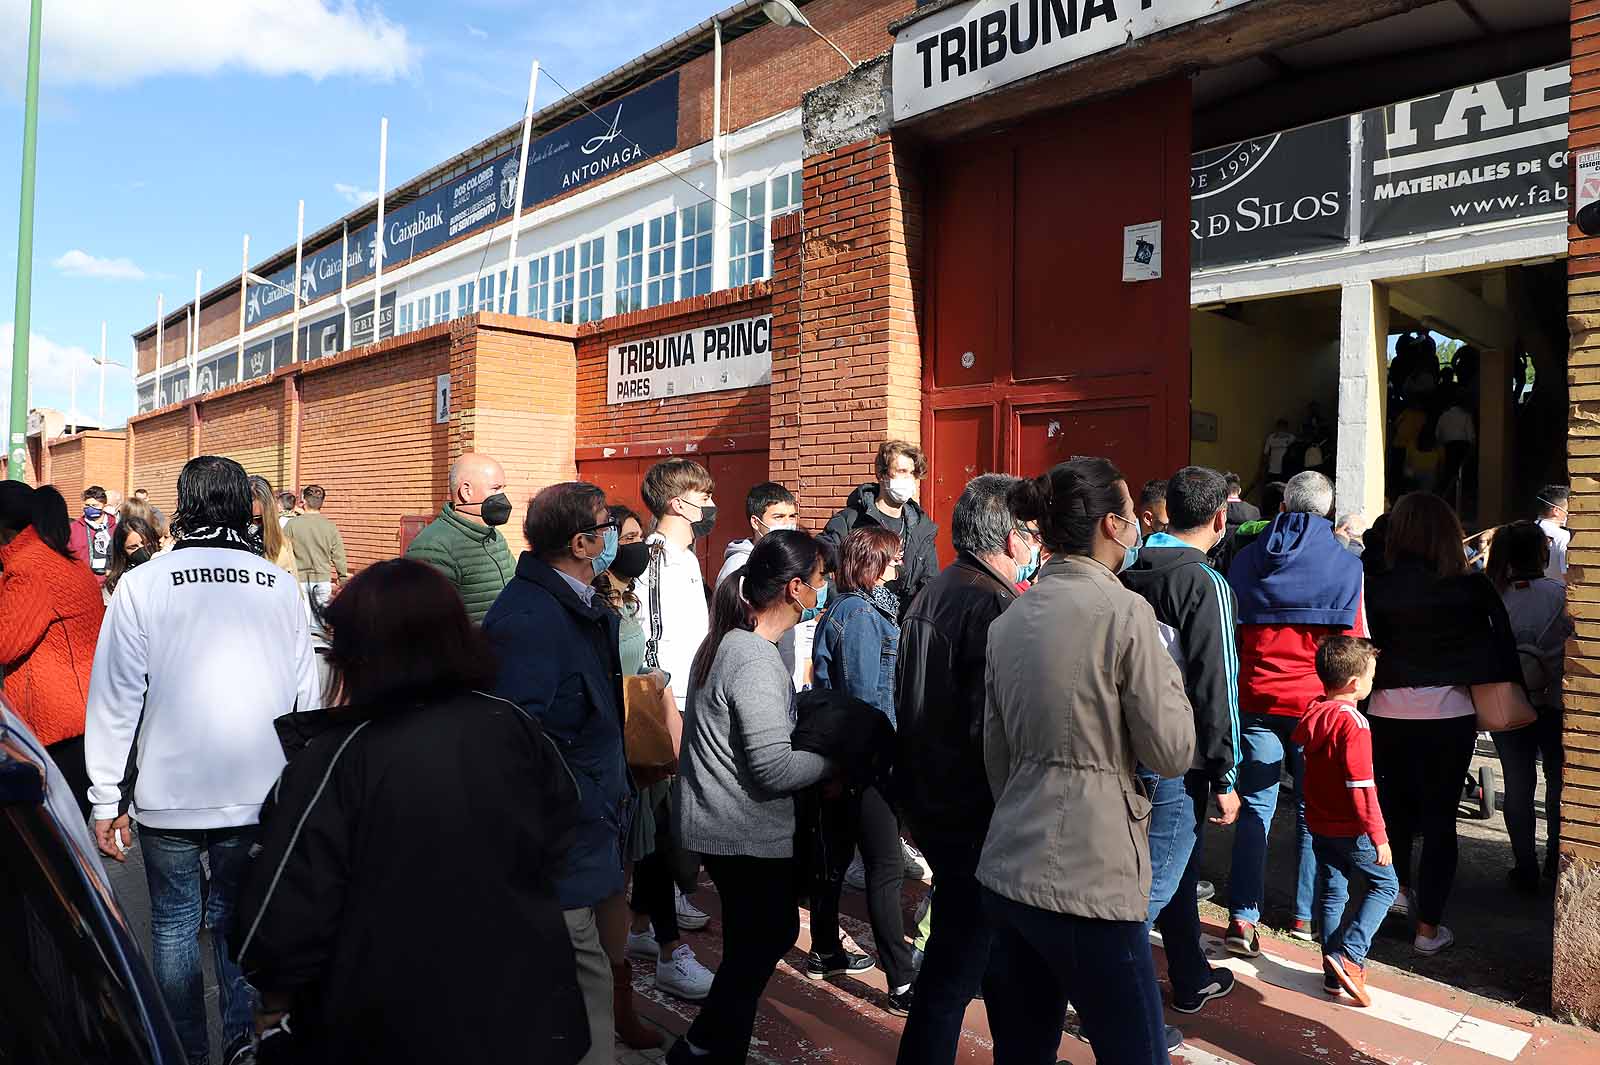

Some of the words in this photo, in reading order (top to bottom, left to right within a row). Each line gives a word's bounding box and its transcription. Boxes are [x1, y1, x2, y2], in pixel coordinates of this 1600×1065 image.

[916, 0, 1117, 89] TRIBUNA
[562, 144, 642, 188] ANTONAGA
[1218, 143, 1261, 181] 1994
[1373, 161, 1511, 201] MATERIALES
[1516, 159, 1541, 176] DE
[1548, 151, 1568, 169] C
[454, 183, 467, 200] DOS
[390, 203, 443, 245] CaixaBank
[319, 242, 363, 280] Caixaank
[354, 310, 392, 332] FRIAS
[618, 333, 695, 375] TRIBUNA
[617, 378, 650, 400] PARES
[170, 567, 250, 586] BURGOS
[255, 571, 276, 588] CF
